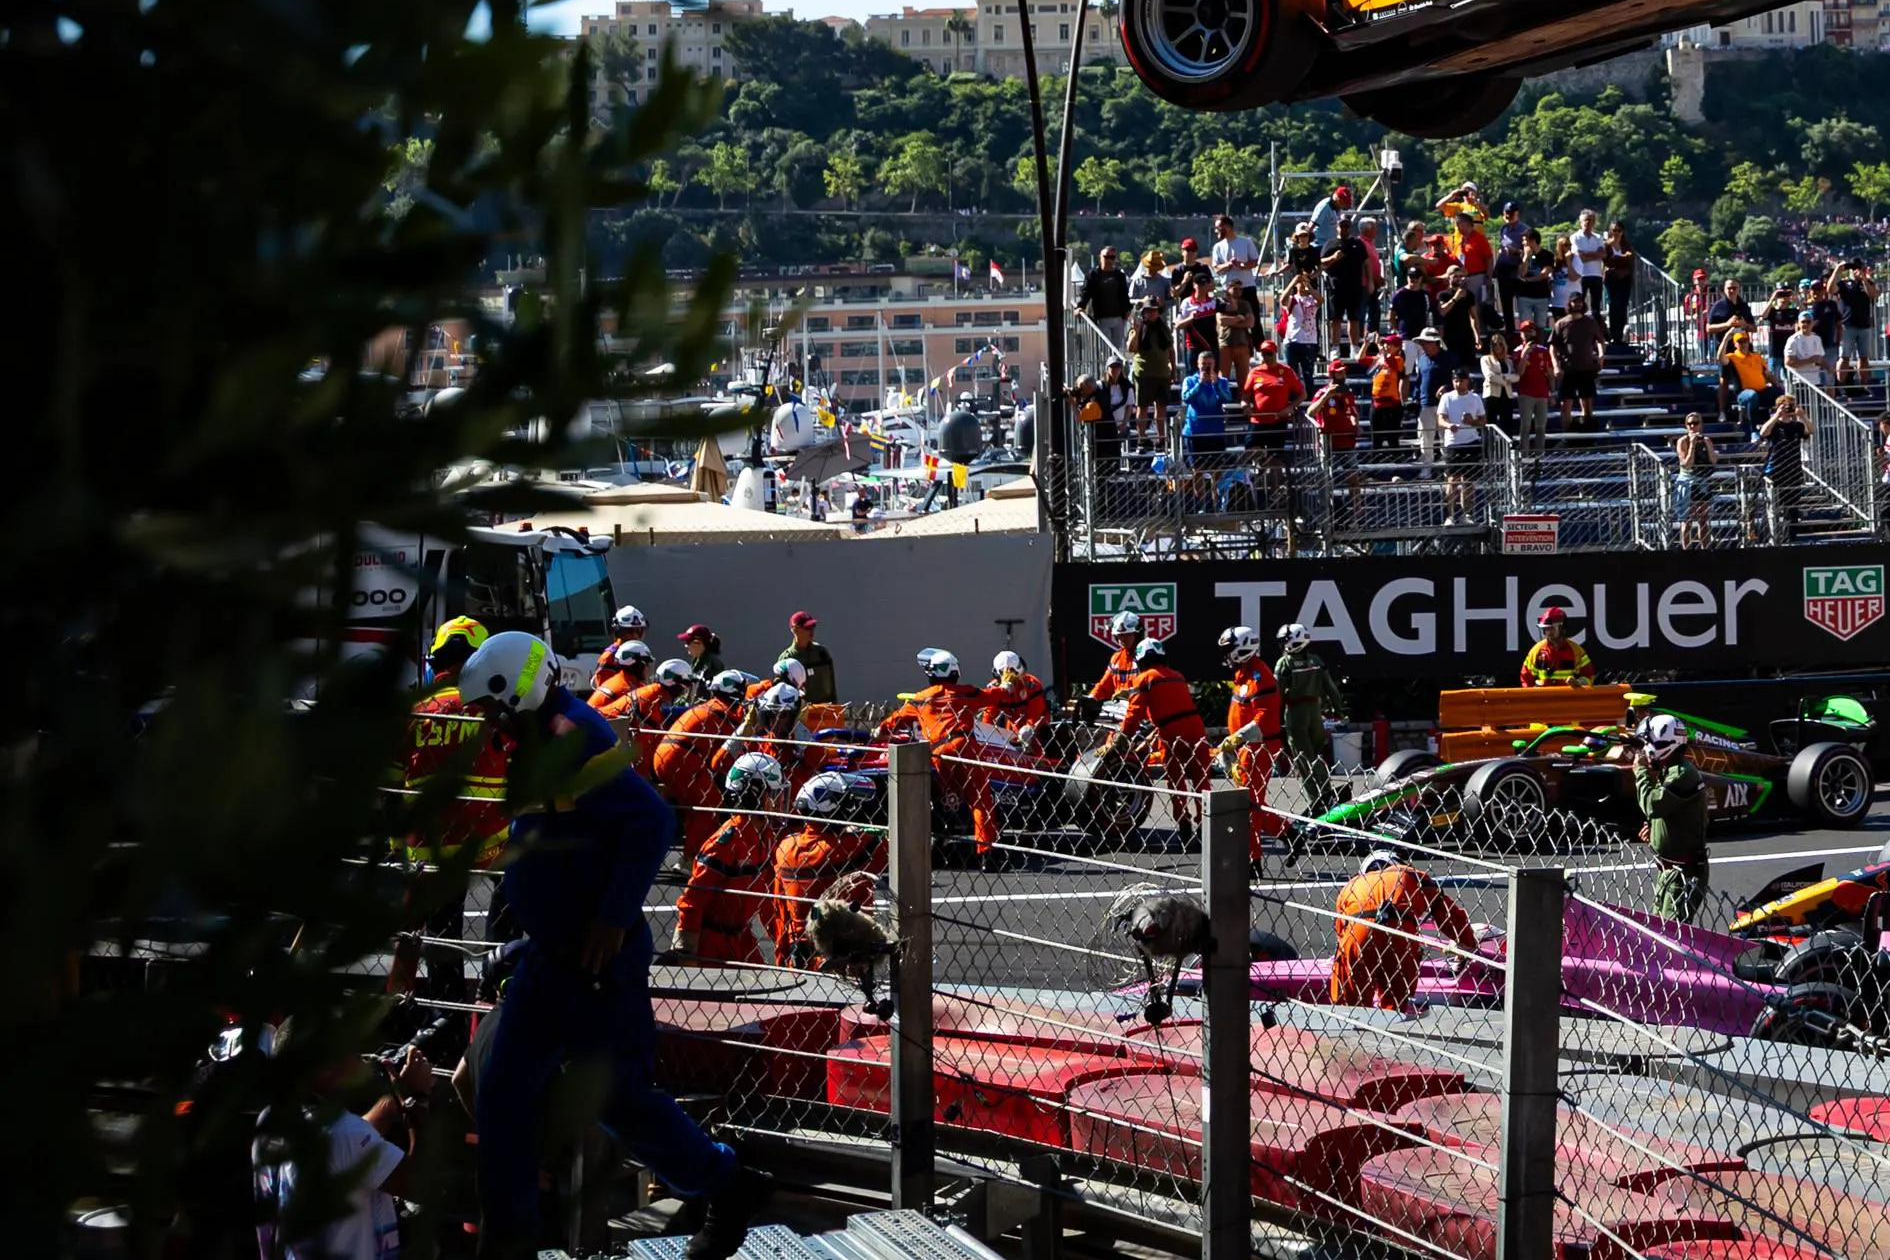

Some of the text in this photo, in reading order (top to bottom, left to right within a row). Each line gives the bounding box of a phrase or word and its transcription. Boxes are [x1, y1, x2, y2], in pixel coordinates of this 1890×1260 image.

[1507, 534, 1553, 542] INTERVENTION
[1520, 544, 1553, 552] BRAVO
[355, 551, 406, 566] DULO
[1811, 570, 1877, 594] TAG
[353, 588, 407, 607] 000
[1097, 588, 1169, 612] TAG
[1214, 576, 1770, 655] TAGHeuer
[1808, 599, 1880, 634] HEUER
[1093, 617, 1172, 640] HER
[1695, 731, 1740, 751] RACING
[1724, 783, 1749, 809] AIX
